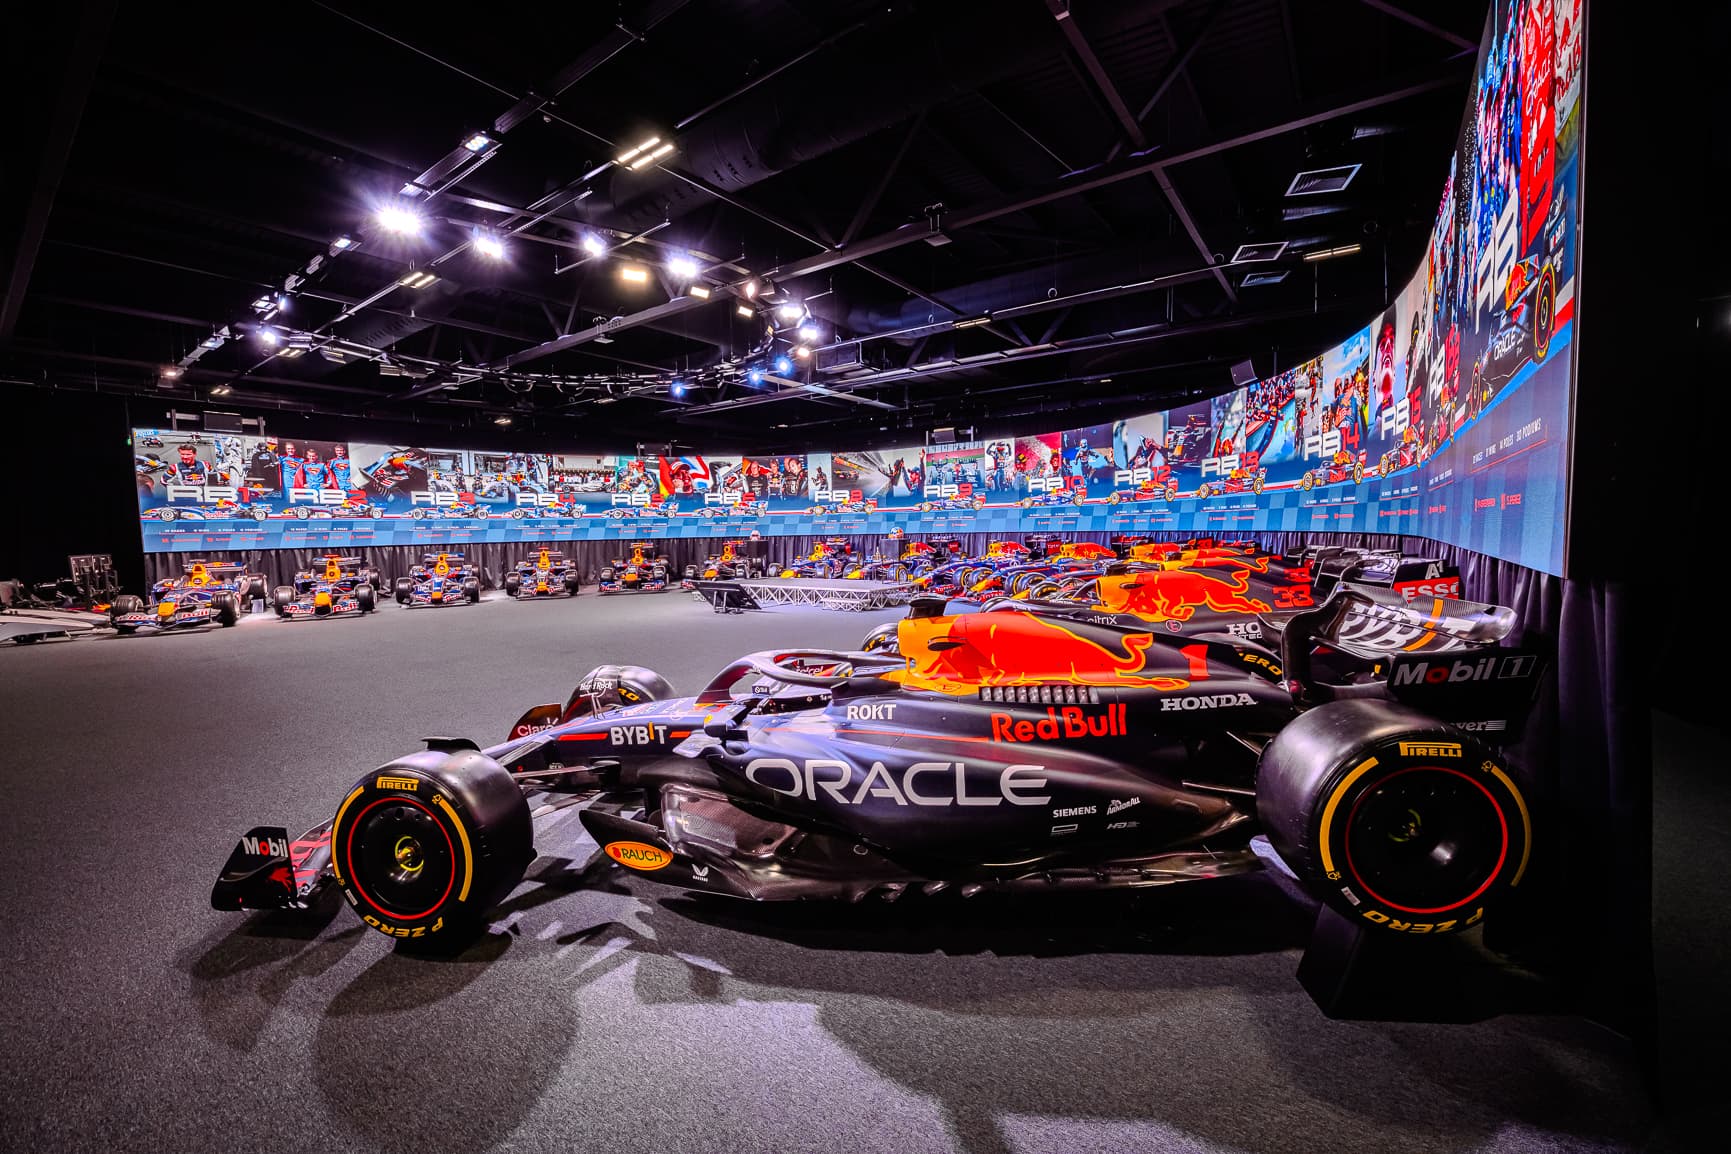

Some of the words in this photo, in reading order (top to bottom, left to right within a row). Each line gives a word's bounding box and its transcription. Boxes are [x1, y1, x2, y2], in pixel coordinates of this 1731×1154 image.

[1381, 386, 1421, 440] RB15
[1303, 423, 1360, 461] RB14
[1201, 451, 1259, 477] RB13
[1027, 475, 1085, 493] RB10
[1114, 465, 1172, 486] RB12
[168, 485, 249, 502] RB1
[289, 488, 368, 504] RB2
[411, 491, 476, 505] RB3
[515, 492, 576, 506] RB4
[611, 493, 665, 506] RB5
[704, 492, 756, 505] RB6
[814, 489, 864, 502] RB8
[924, 483, 973, 498] RB9
[1272, 585, 1314, 608] 33
[1180, 644, 1210, 681] 1
[1394, 657, 1497, 687] Mobil
[1160, 693, 1257, 711] HONDA
[847, 703, 897, 720] ROKT
[990, 705, 1060, 743] Red
[1062, 704, 1127, 738] Bull
[610, 721, 668, 746] BYBIT
[1399, 741, 1463, 758] PIRELLI
[376, 776, 419, 791] PIRELLI
[745, 758, 1051, 806] ORACLE
[1052, 805, 1097, 818] SIEMENS
[242, 836, 289, 858] Mobil
[621, 848, 663, 863] RAUCH
[363, 914, 427, 938] ZERO
[431, 916, 444, 932] P
[1363, 910, 1458, 934] ZERO
